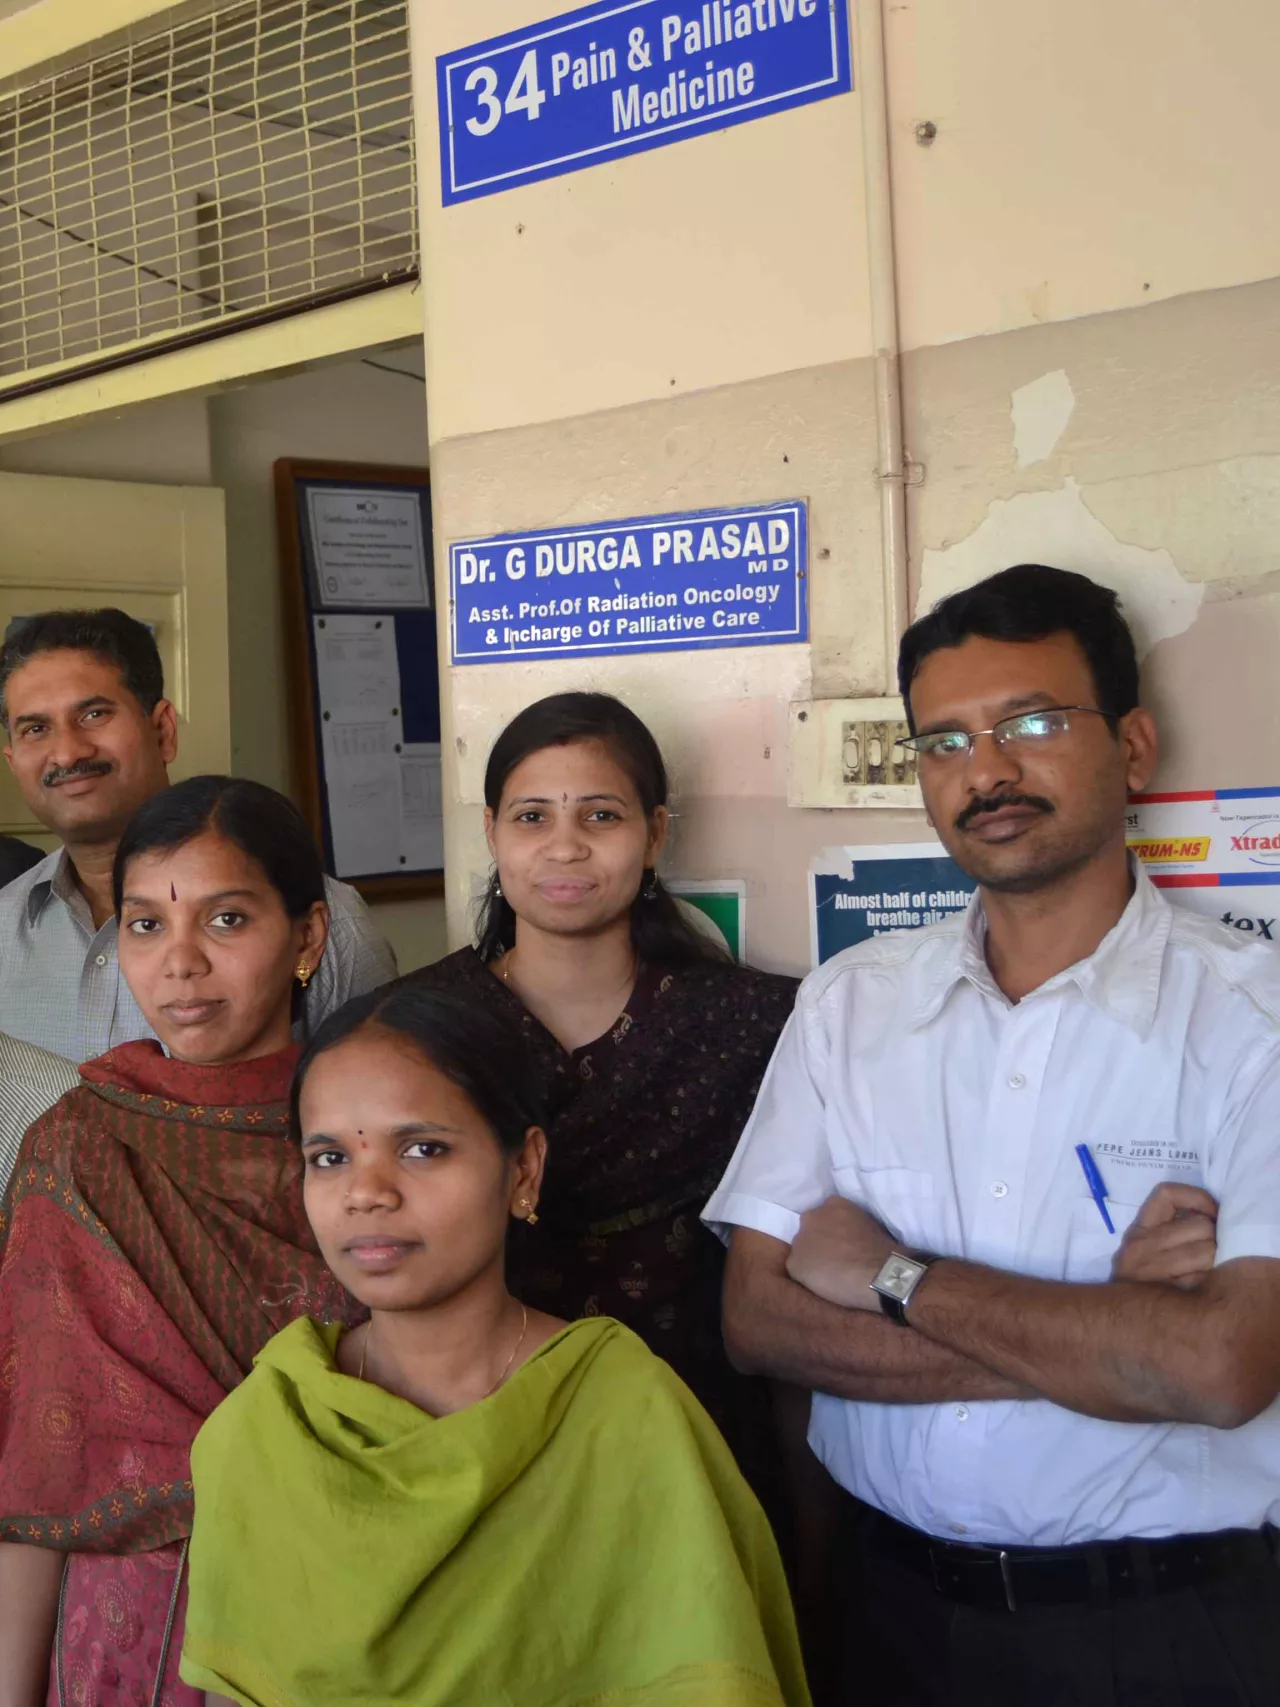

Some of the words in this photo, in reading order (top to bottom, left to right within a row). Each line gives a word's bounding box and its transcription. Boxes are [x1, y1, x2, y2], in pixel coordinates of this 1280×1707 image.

[551, 42, 617, 97] Pain
[627, 27, 652, 72] &
[661, 0, 816, 61] Palliative
[464, 49, 546, 137] 34
[612, 60, 755, 134] Medicine
[460, 553, 497, 585] Dr.
[505, 548, 526, 580] G
[535, 535, 641, 578] DURGA
[652, 519, 790, 566] PRASAD
[469, 605, 514, 623] Asst.
[588, 591, 677, 613] Radiation
[684, 583, 780, 605] Oncology
[485, 628, 498, 644] &
[504, 623, 582, 644] Incharge
[588, 620, 611, 637] Of
[616, 614, 705, 635] Palliative
[712, 609, 760, 628] Care
[835, 893, 881, 910] Almost
[883, 891, 910, 909] half
[912, 891, 927, 908] of
[928, 890, 971, 908] childr
[867, 910, 921, 926] breathe
[1097, 1143, 1124, 1154] PEPE
[1129, 1148, 1162, 1158] JEANS
